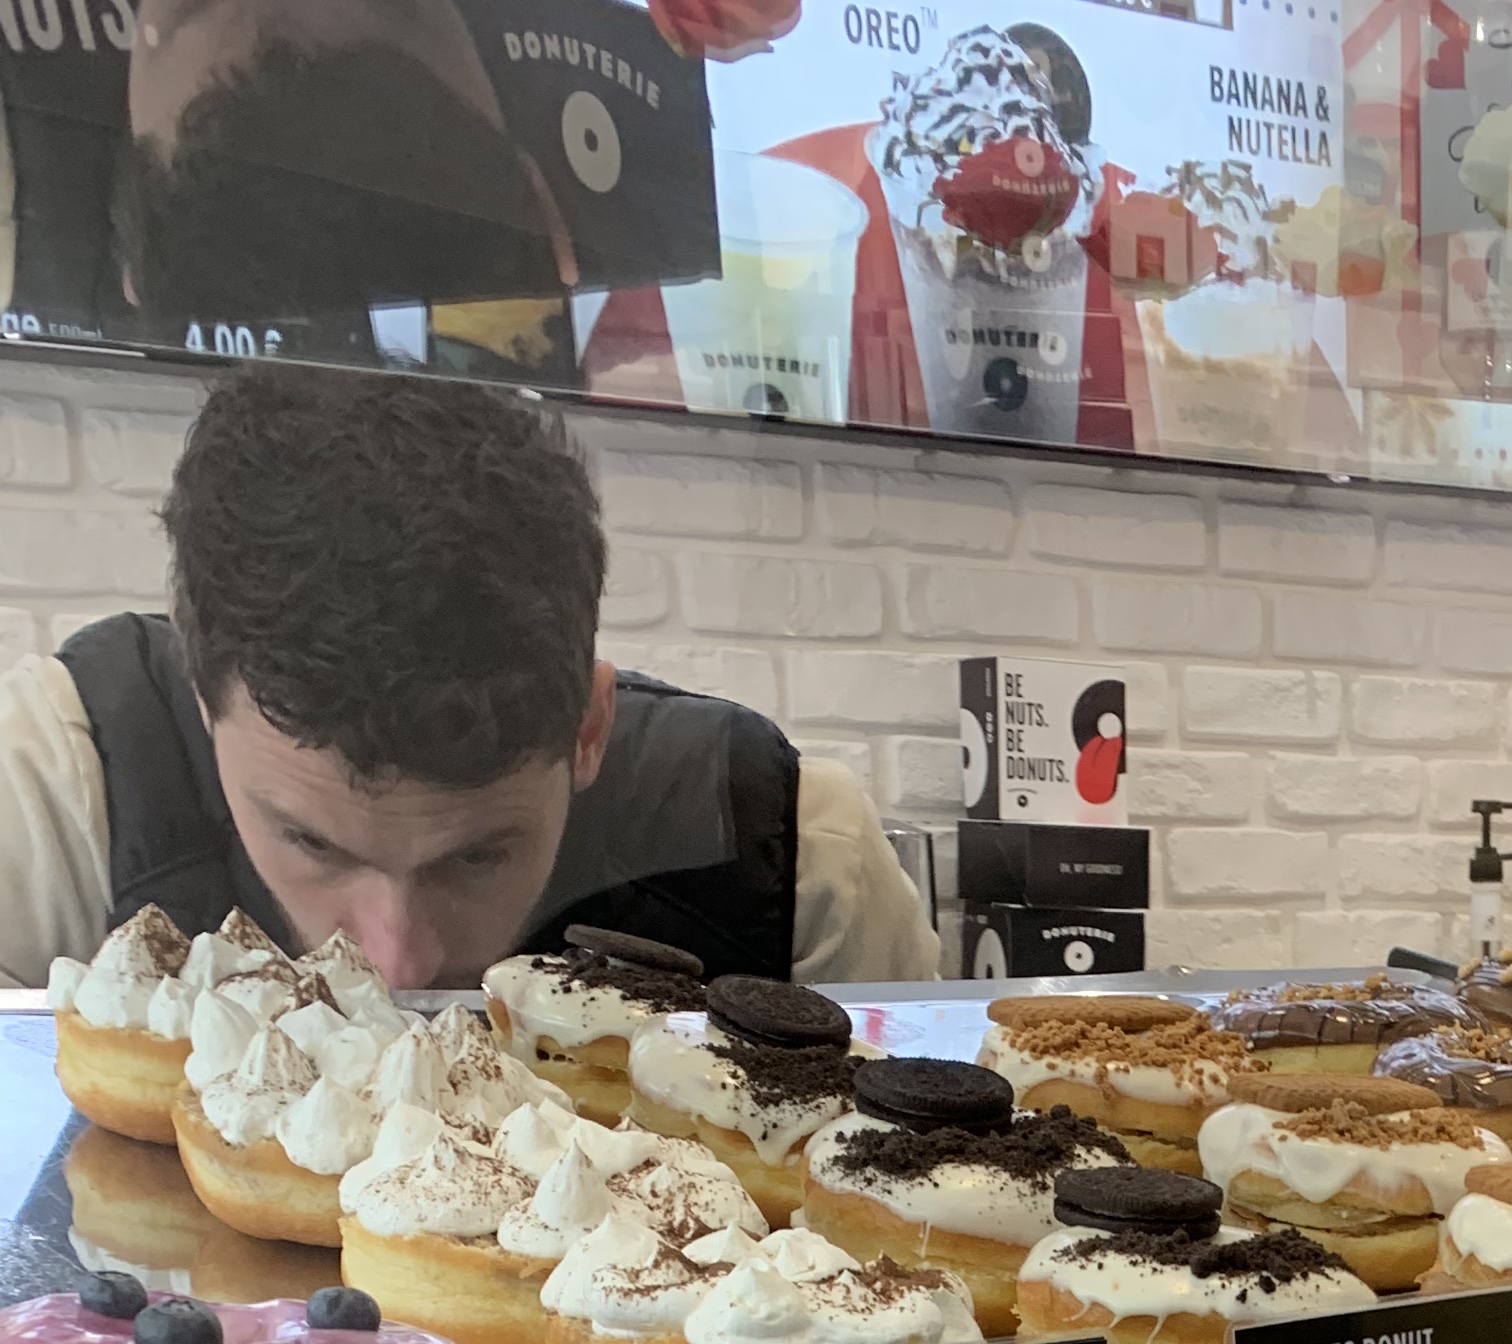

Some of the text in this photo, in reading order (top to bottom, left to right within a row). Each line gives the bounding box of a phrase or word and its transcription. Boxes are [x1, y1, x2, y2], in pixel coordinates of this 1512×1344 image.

[505, 32, 660, 110] DONUTERIE
[1209, 64, 1331, 122] BANANA &
[1228, 115, 1332, 167] NUTELLA
[1004, 672, 1024, 698] BE
[1005, 701, 1050, 728] NUTS.
[1006, 729, 1025, 753] BE
[1006, 756, 1070, 784] DONUTS.
